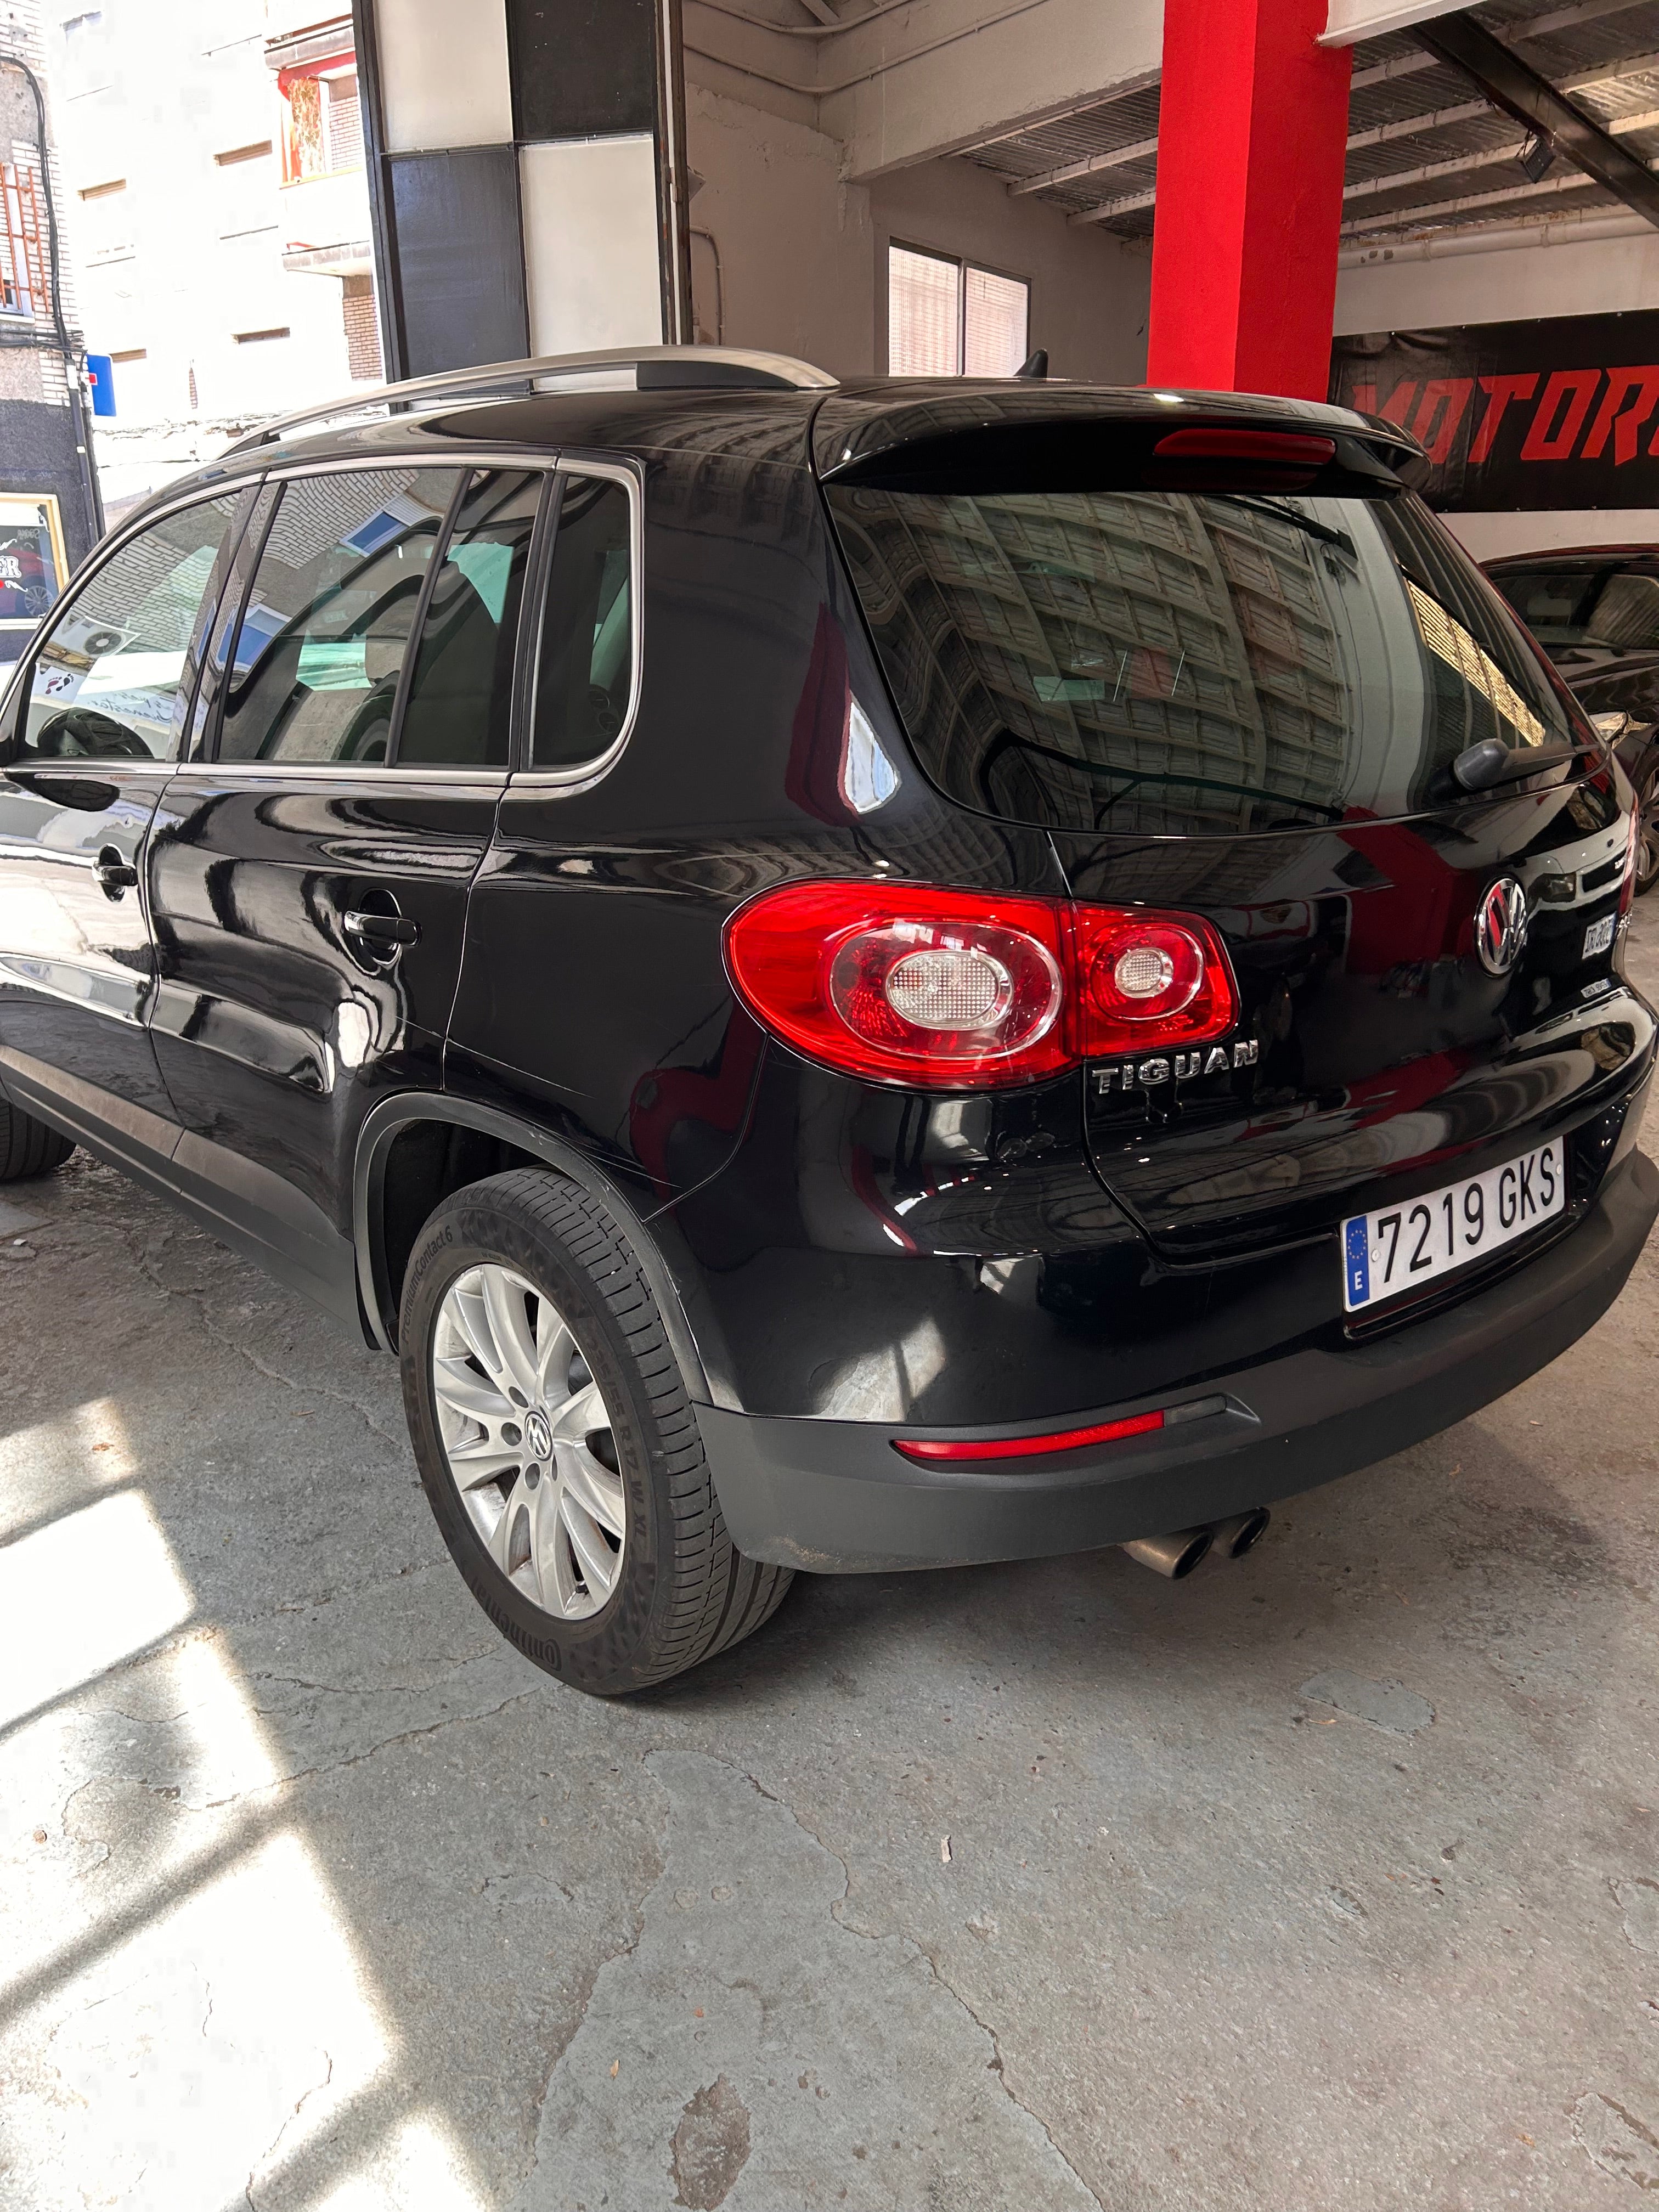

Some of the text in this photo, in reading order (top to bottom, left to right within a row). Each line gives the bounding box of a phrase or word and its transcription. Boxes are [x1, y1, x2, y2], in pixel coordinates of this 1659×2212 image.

[1092, 1039, 1259, 1094] TIGUAN
[1378, 1148, 1556, 1283] 7219 GKS
[401, 1224, 453, 1345] PremiumContact 6
[1354, 1270, 1363, 1290] E
[471, 1577, 562, 1672] Continental
